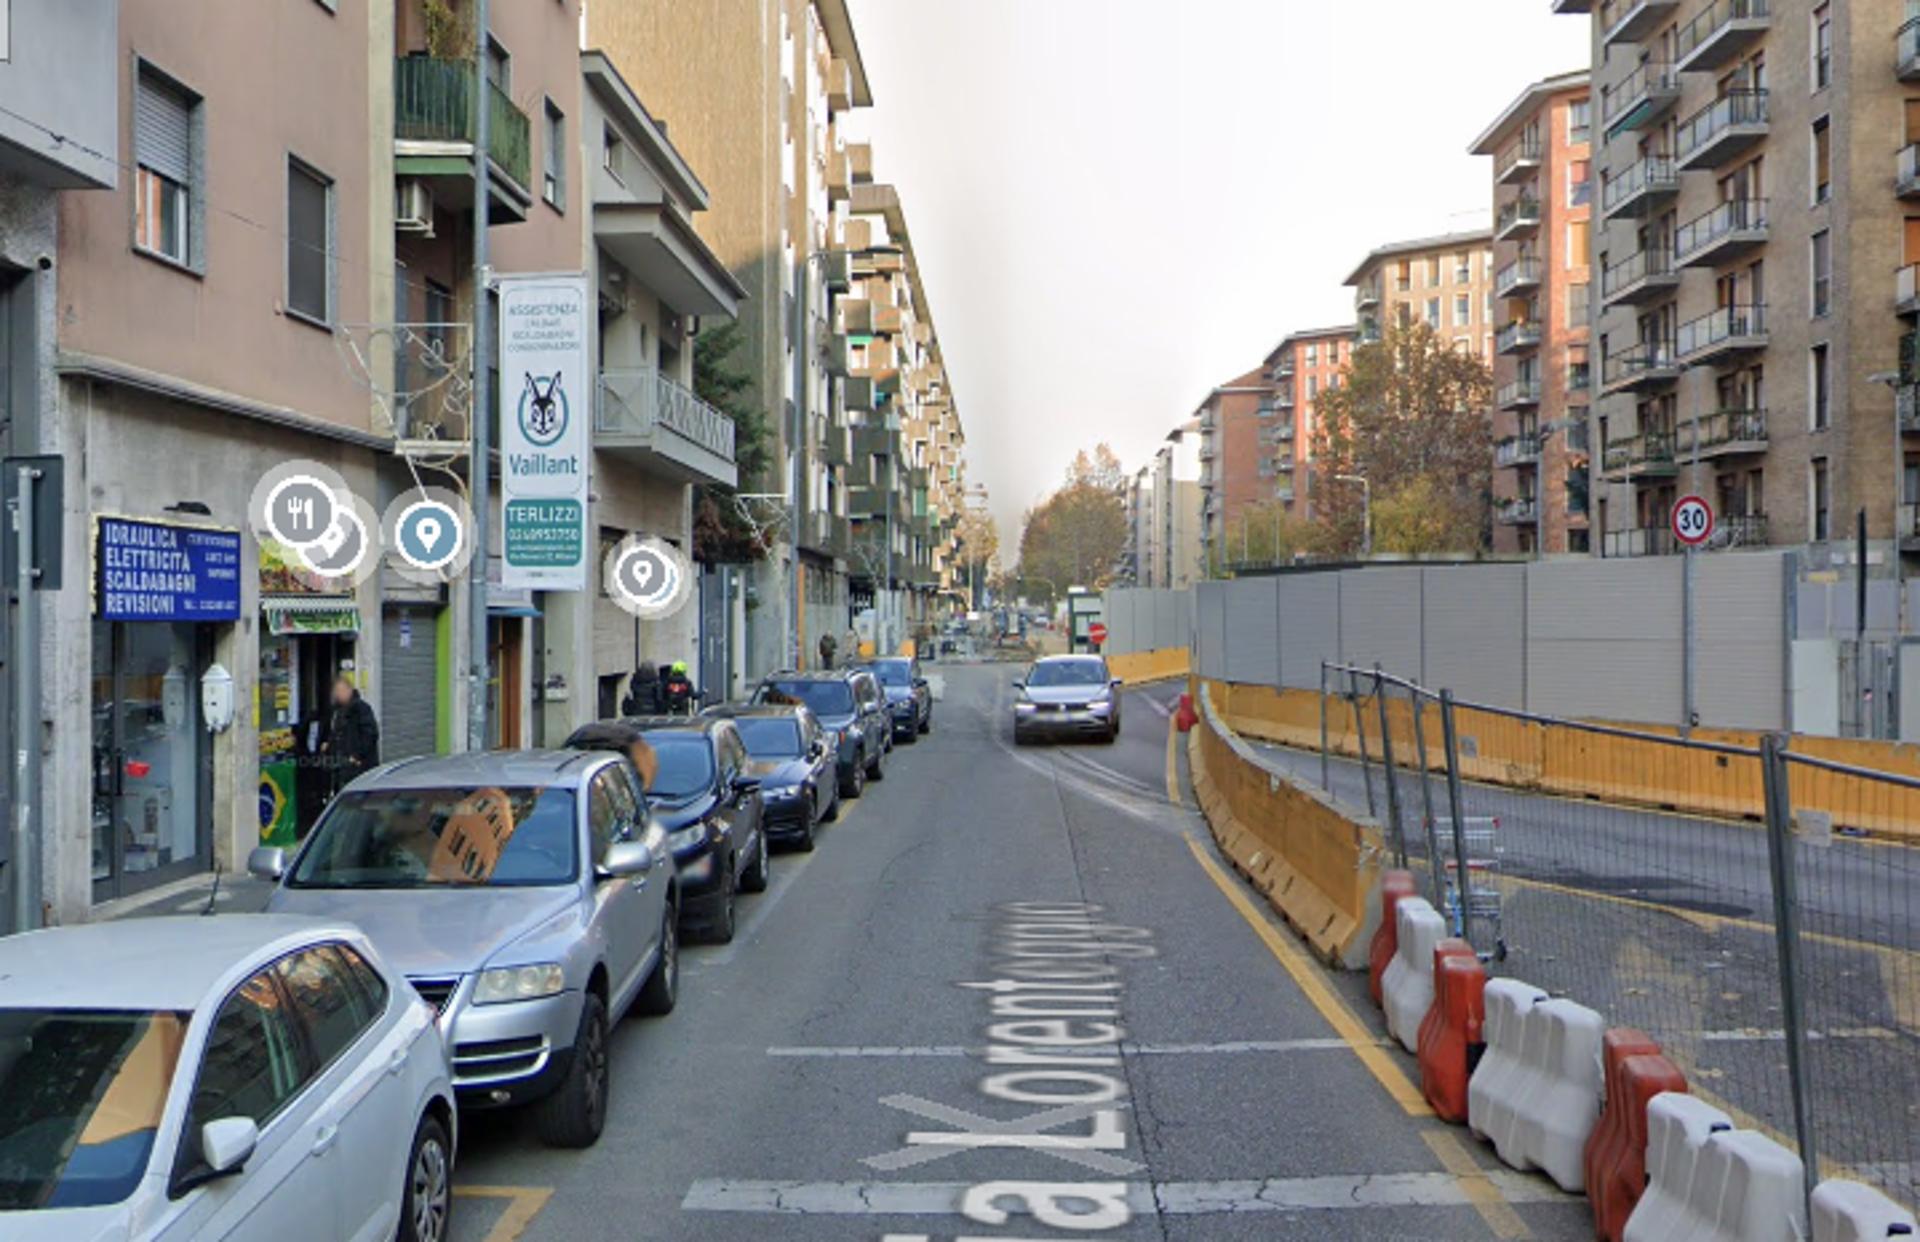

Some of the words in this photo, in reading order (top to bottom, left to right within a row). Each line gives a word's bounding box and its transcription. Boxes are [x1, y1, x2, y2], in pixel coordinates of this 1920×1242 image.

[508, 303, 578, 316] ASSISTENZA
[509, 454, 578, 475] Vaillant
[507, 506, 579, 523] TERLIZZI
[1680, 508, 1705, 531] 30
[105, 523, 178, 548] IDRAULICA
[105, 546, 191, 573] ELETTRICITÀ
[105, 569, 196, 593] SCALDABAGNI
[105, 592, 175, 614] REVISIONI
